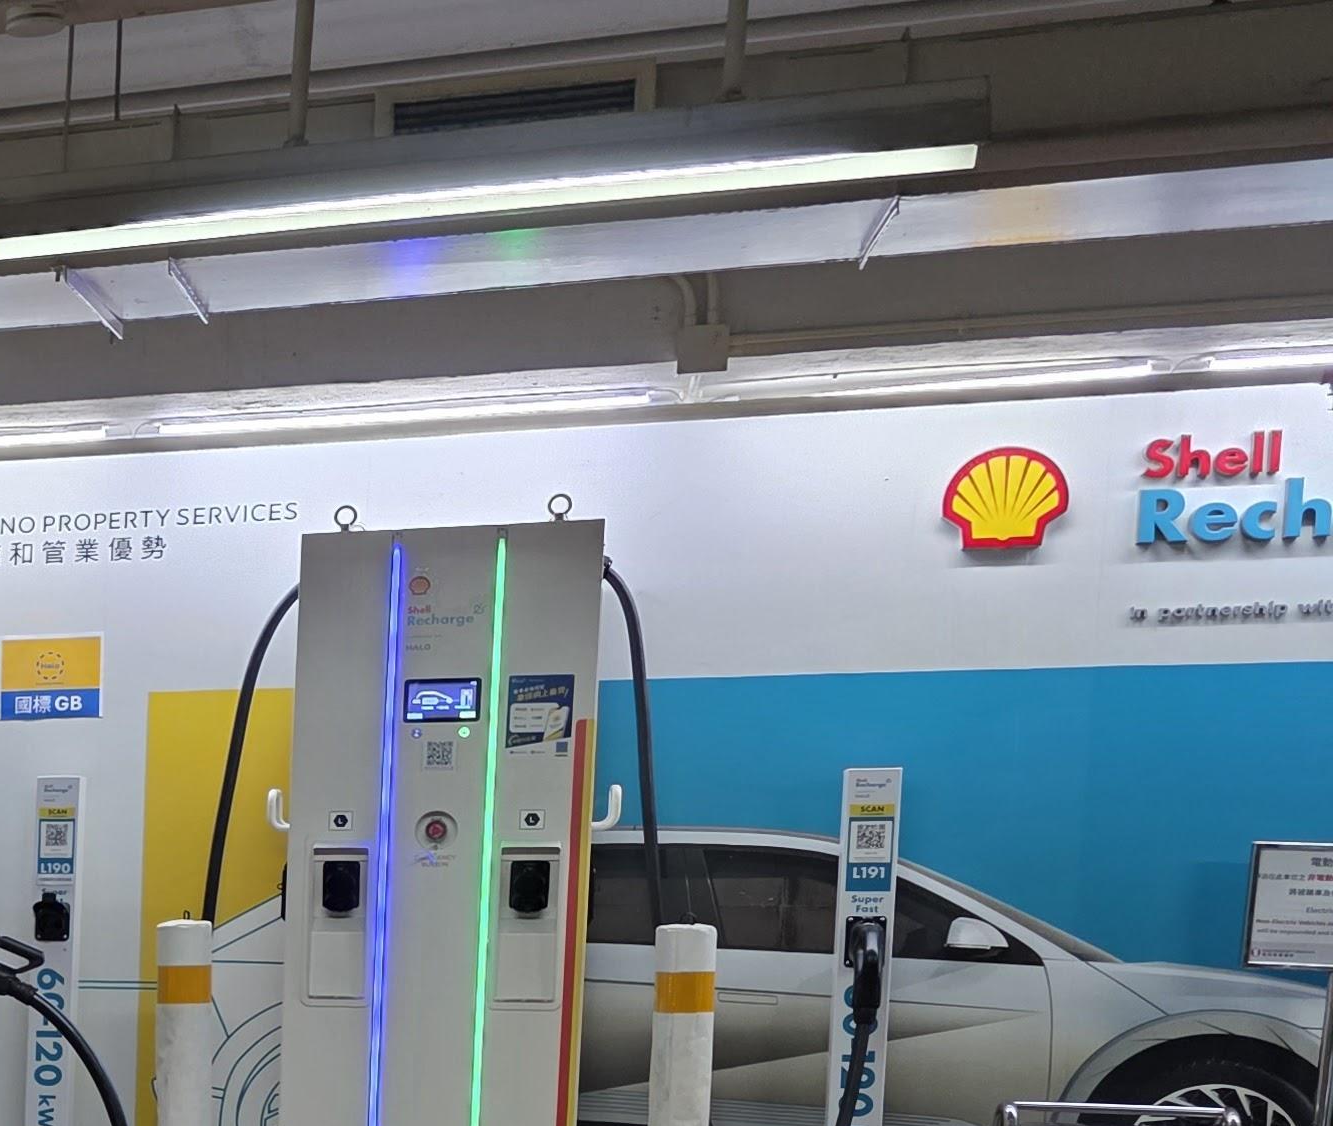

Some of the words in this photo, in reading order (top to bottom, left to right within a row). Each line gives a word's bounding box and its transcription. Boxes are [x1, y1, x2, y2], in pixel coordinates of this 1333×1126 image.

[1140, 429, 1283, 480] Shell
[42, 508, 172, 534] PROPERTY
[176, 501, 299, 527] SERVICES
[1135, 476, 1333, 546] Rech
[1158, 600, 1288, 624] partnership
[407, 613, 475, 627] Recharge
[14, 695, 52, 715] 國標
[54, 694, 83, 712] GB
[860, 804, 885, 813] SCAN
[40, 862, 71, 874] L190
[852, 866, 886, 879] L191
[851, 894, 885, 904] Super
[855, 904, 879, 913] Fast
